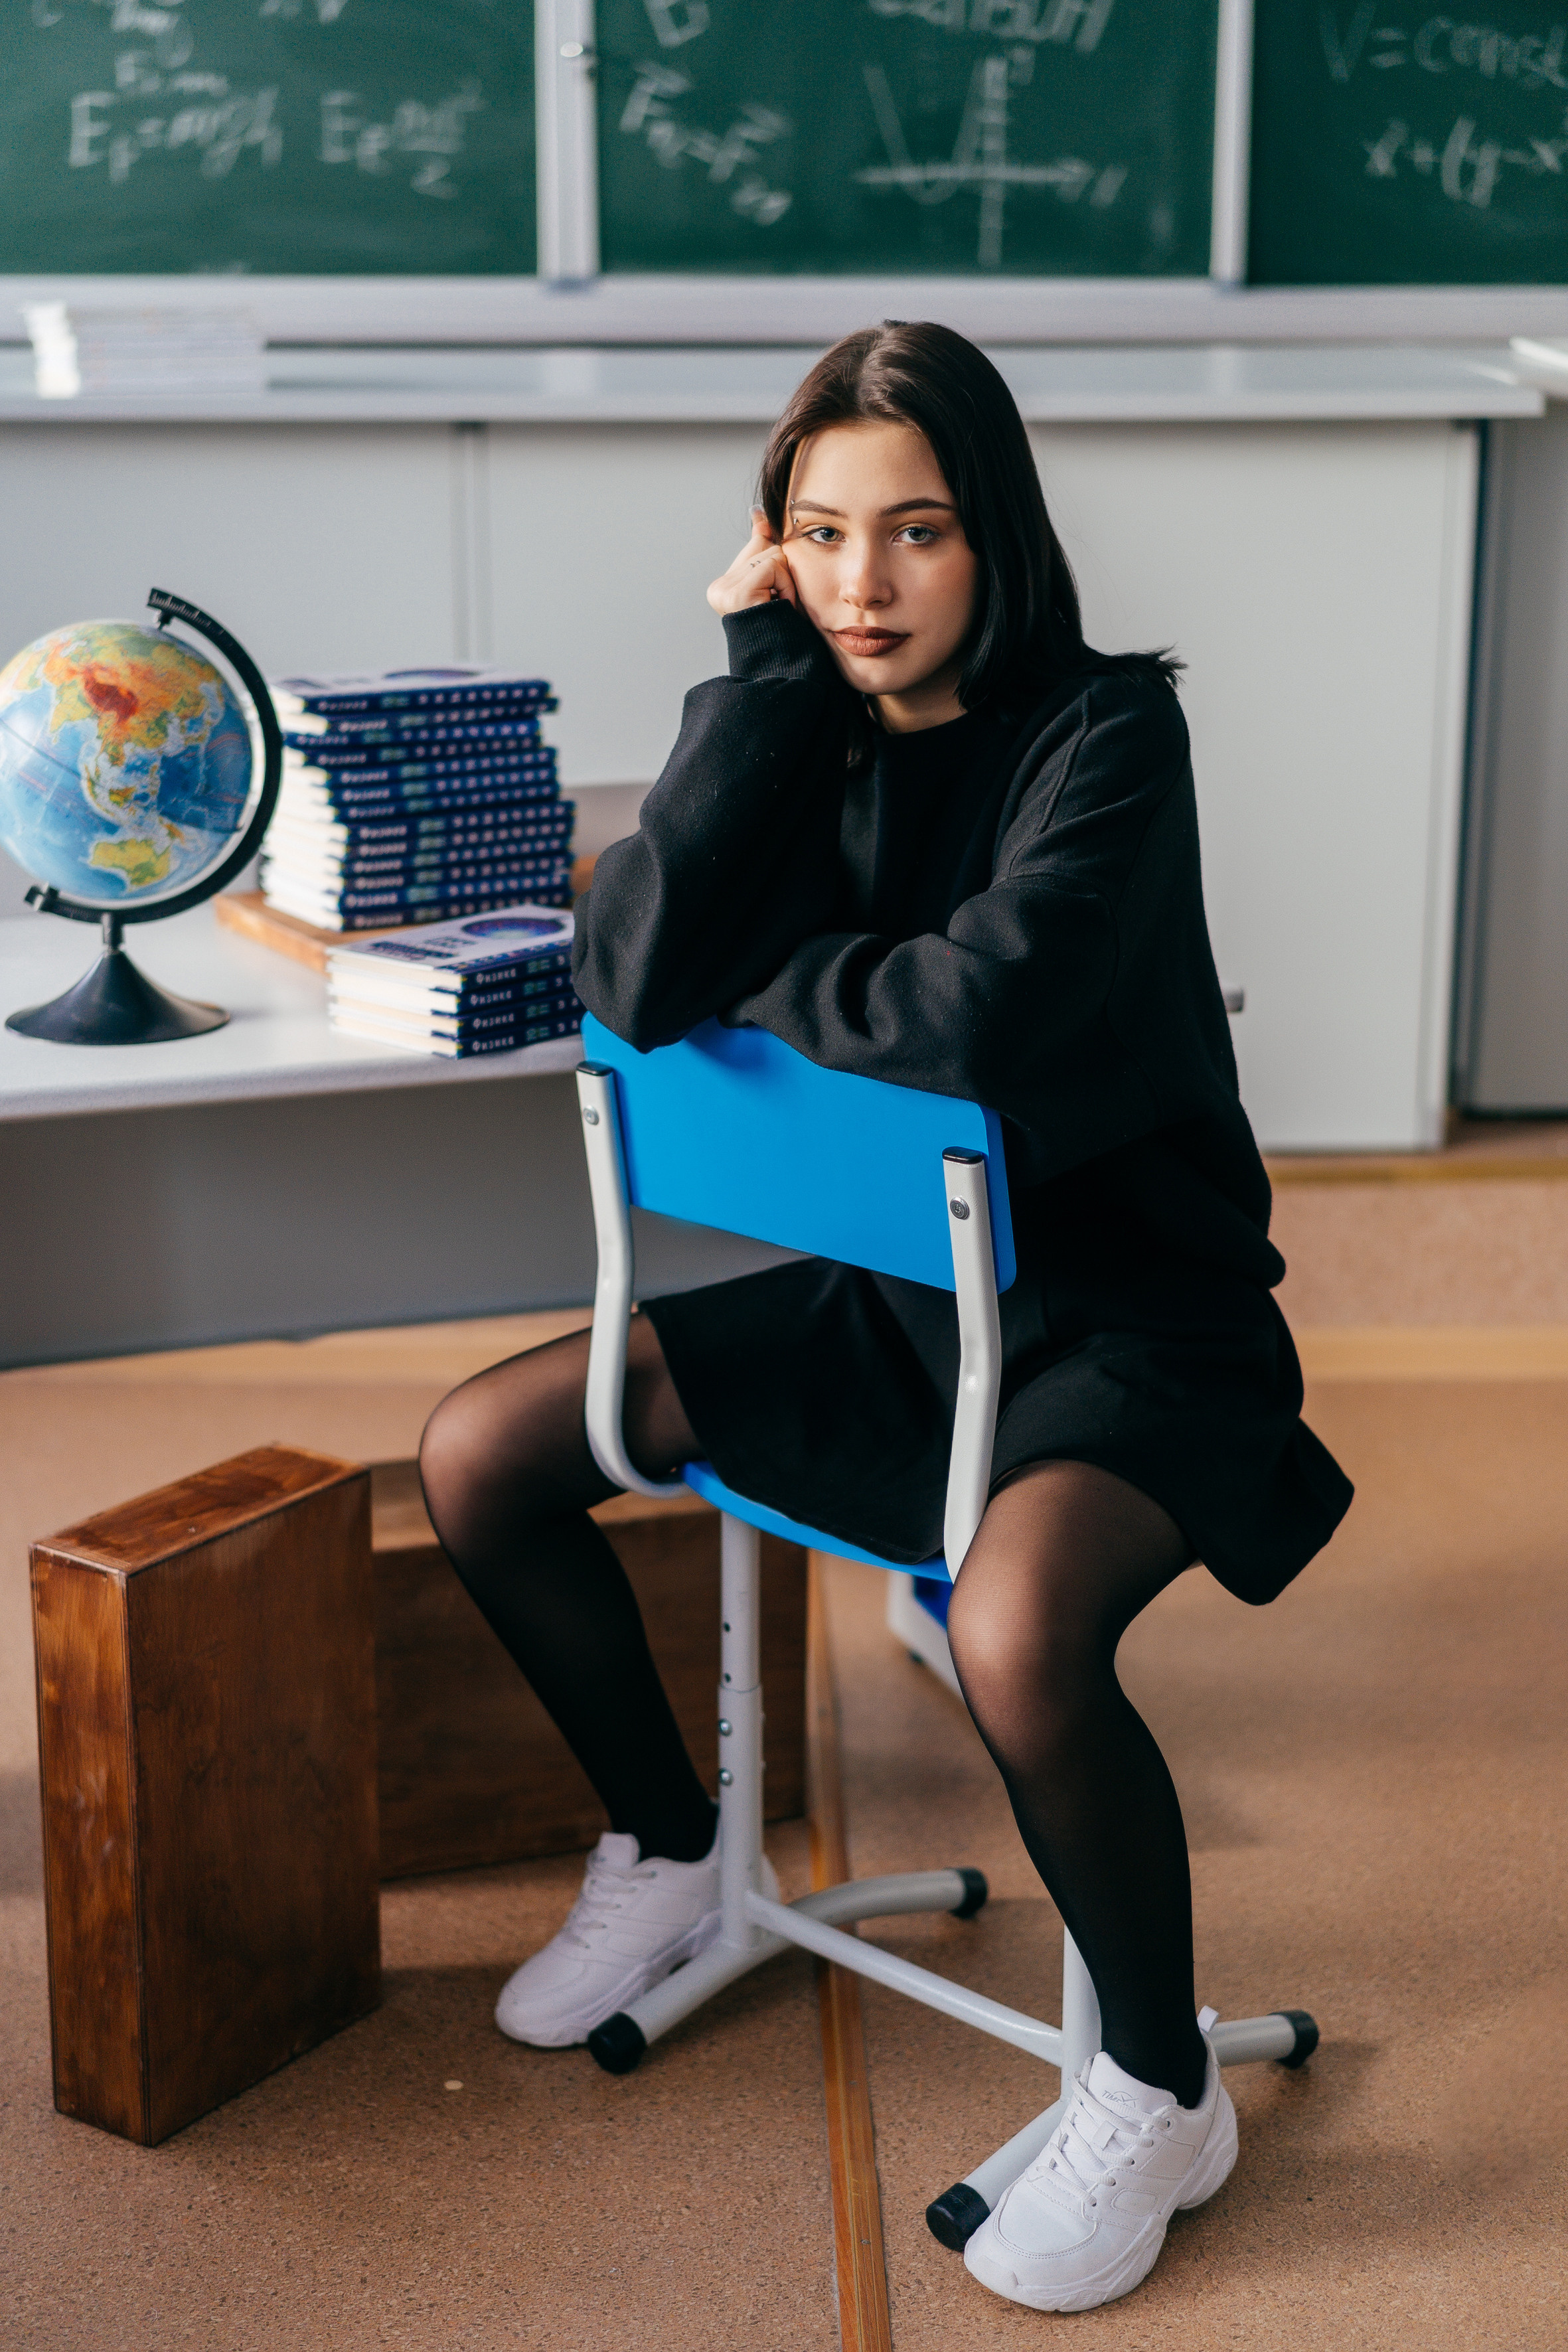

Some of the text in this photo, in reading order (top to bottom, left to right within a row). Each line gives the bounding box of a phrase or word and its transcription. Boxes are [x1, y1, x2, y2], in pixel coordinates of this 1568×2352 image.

[476, 968, 516, 984] Физика
[471, 990, 512, 1006] Физика
[473, 1013, 514, 1030] Физика
[473, 1036, 514, 1052] Физика
